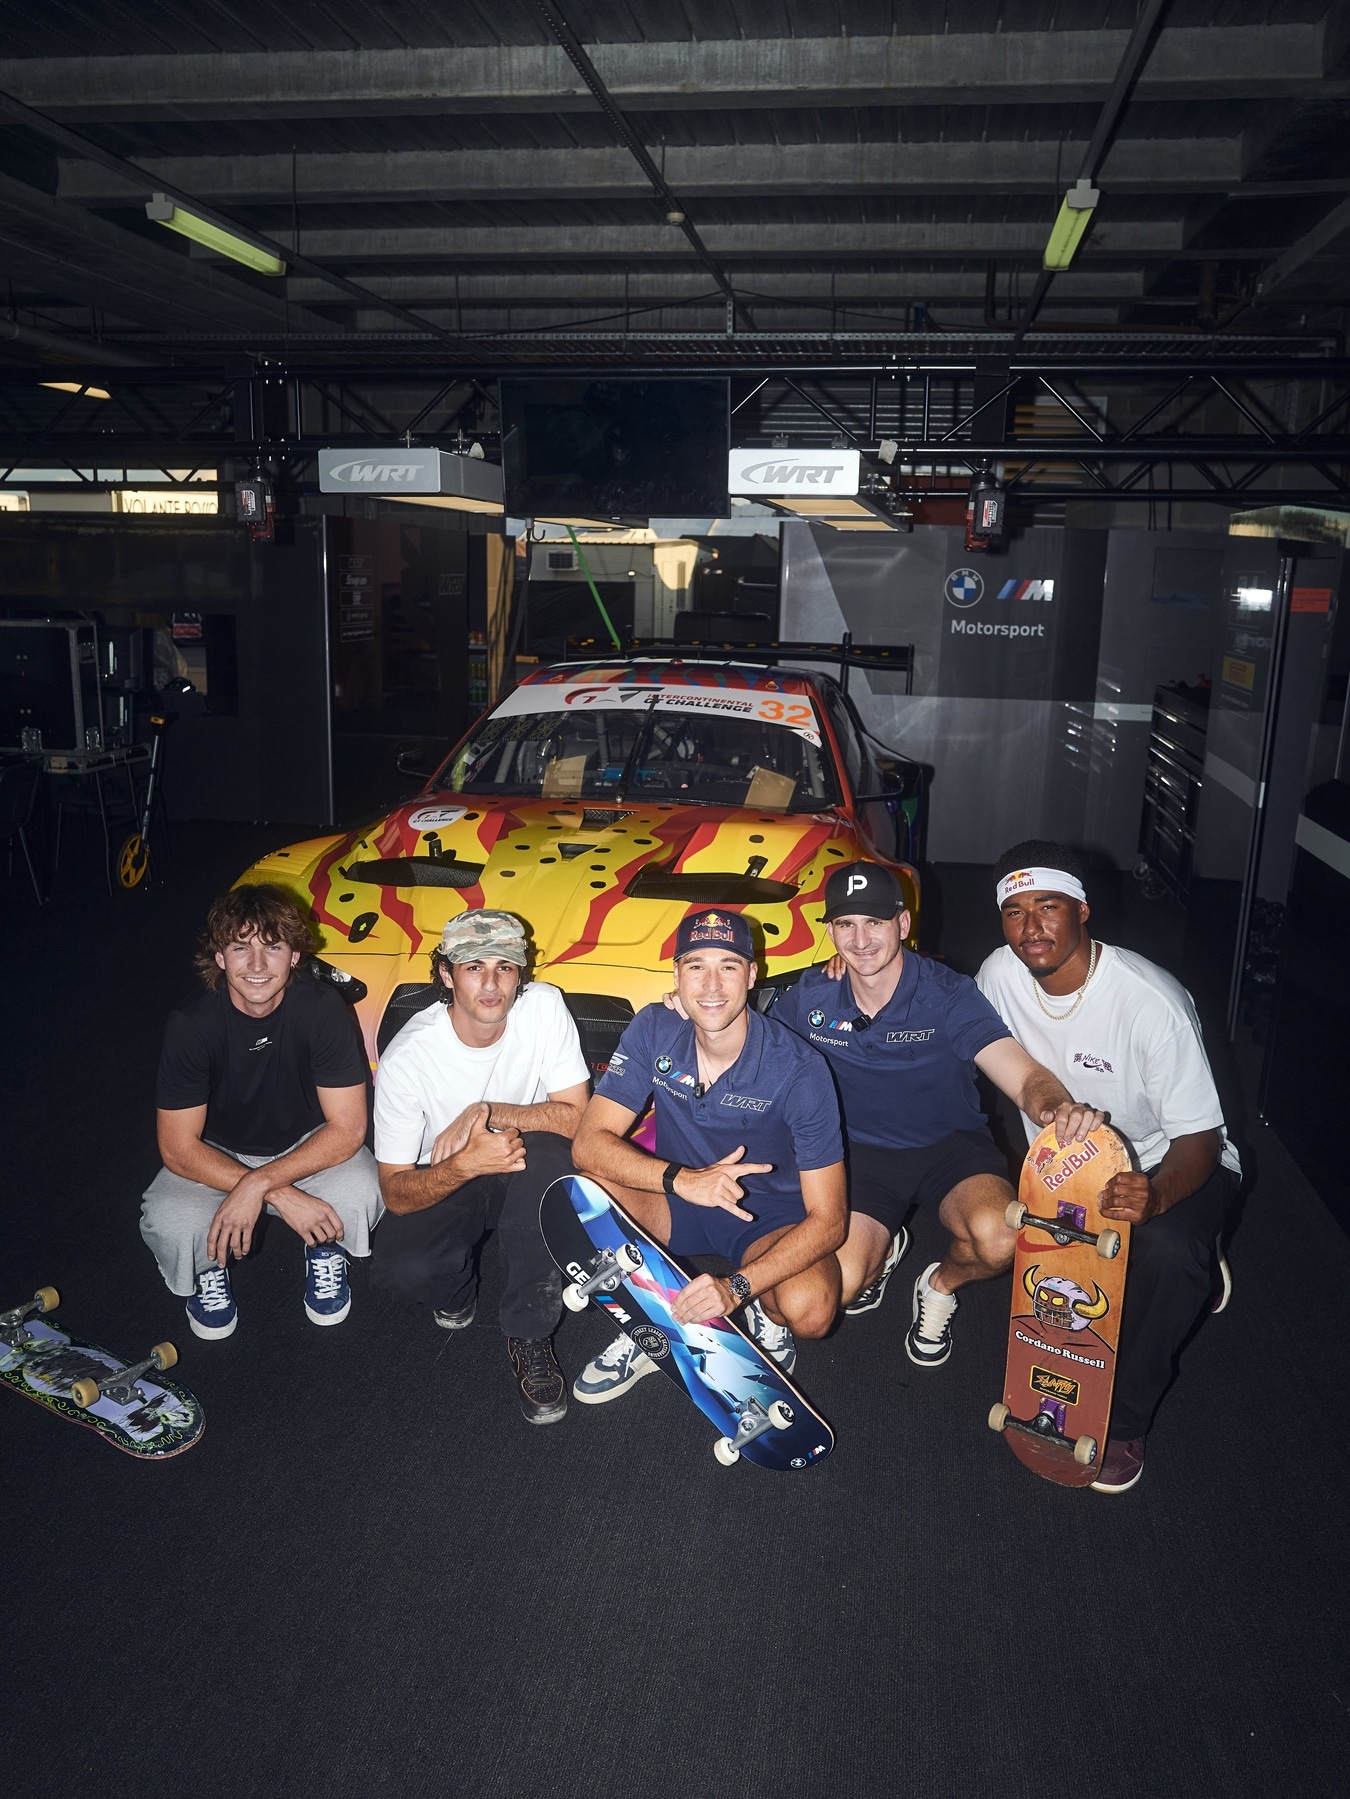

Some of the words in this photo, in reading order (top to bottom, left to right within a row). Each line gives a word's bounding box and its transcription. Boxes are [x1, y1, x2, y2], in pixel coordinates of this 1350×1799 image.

[349, 464, 424, 482] WRT
[762, 465, 844, 484] WRT
[951, 619, 1045, 639] Motorsport
[665, 698, 753, 713] CHALLENGE
[758, 699, 813, 727] 32
[1004, 883, 1018, 895] Red
[1018, 878, 1035, 888] Bull
[689, 928, 711, 943] Red
[712, 928, 735, 943] Bull
[809, 1032, 849, 1047] Motorsport
[886, 1028, 936, 1043] WRT
[1081, 1053, 1101, 1065] NIKE
[652, 1076, 688, 1101] Motorsport
[720, 1093, 773, 1112] WRT
[1041, 1158, 1075, 1192] Red
[1066, 1138, 1100, 1172] Bull
[647, 1327, 665, 1339] LEAGUE
[1015, 1330, 1062, 1356] Cordano
[1062, 1348, 1105, 1369] Russell
